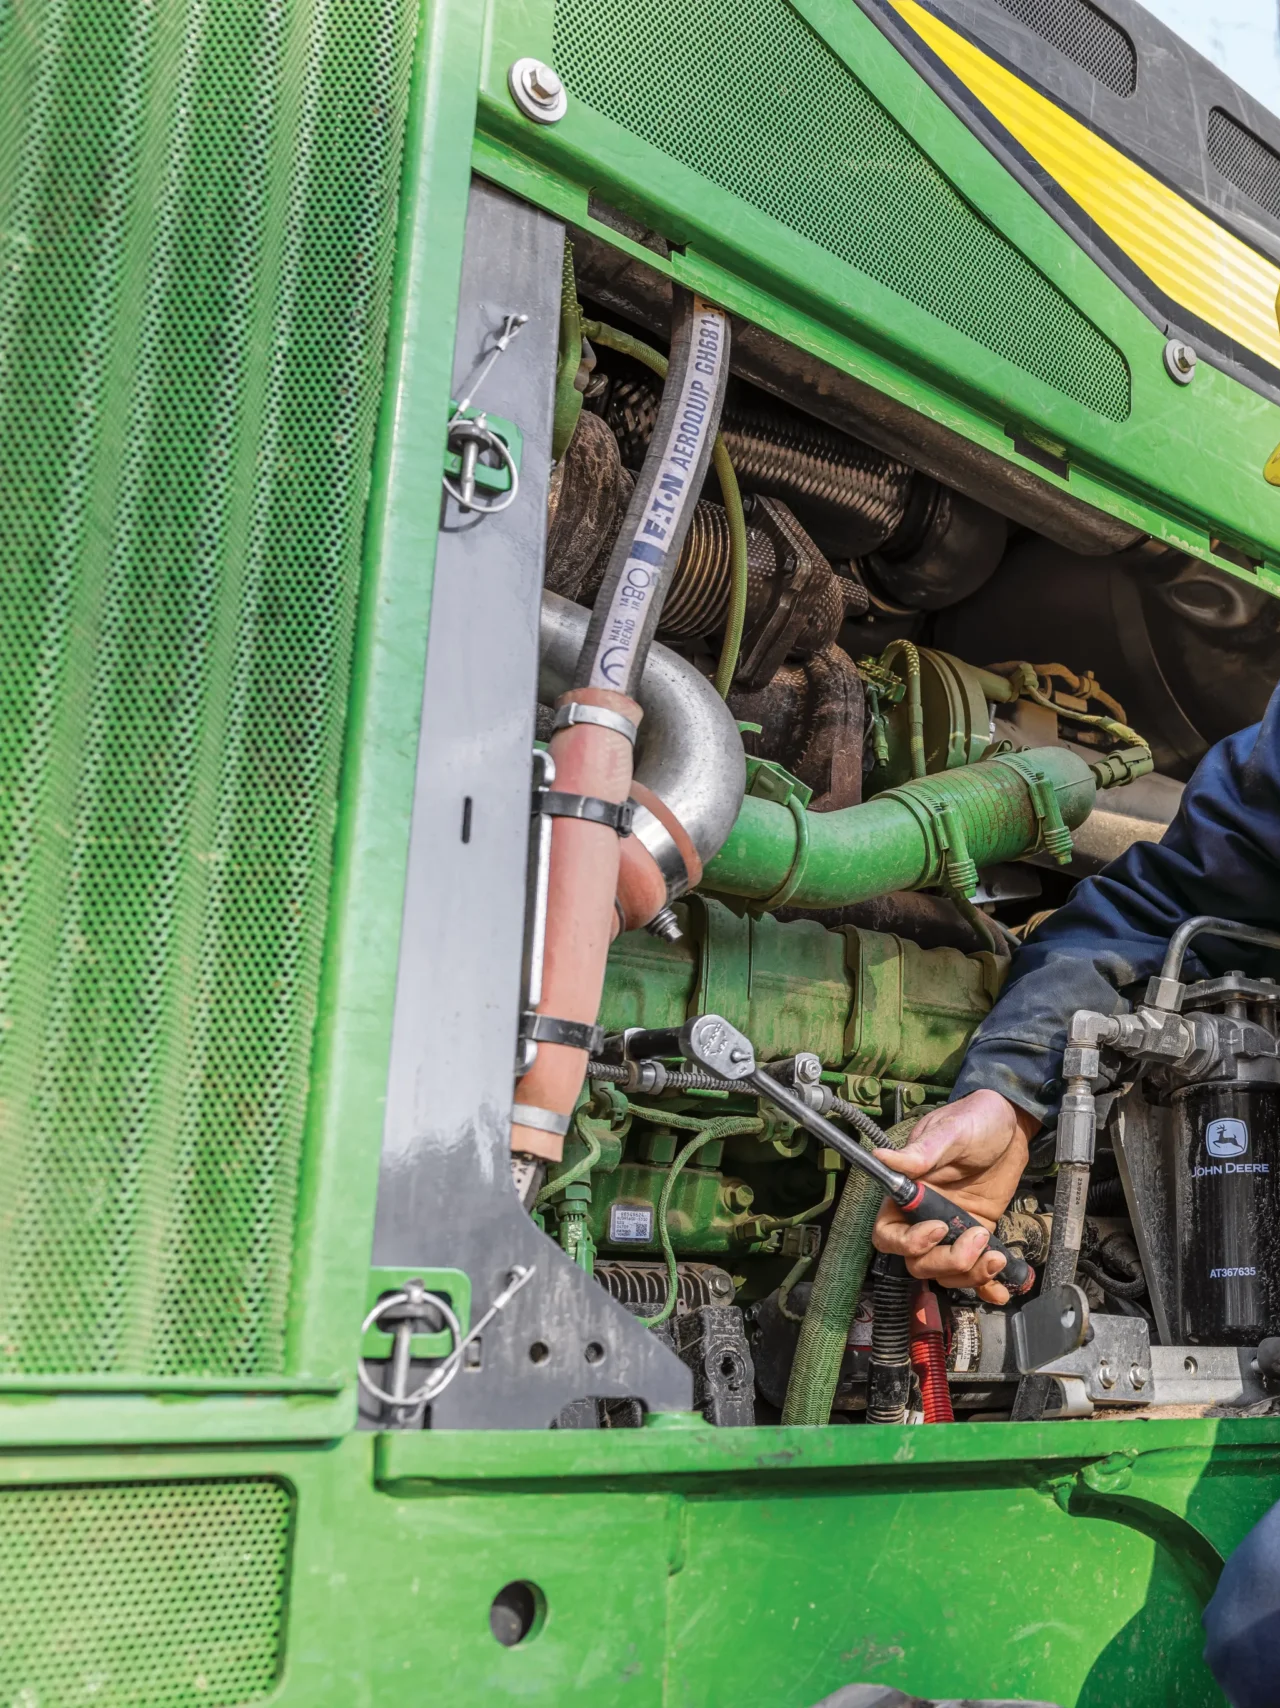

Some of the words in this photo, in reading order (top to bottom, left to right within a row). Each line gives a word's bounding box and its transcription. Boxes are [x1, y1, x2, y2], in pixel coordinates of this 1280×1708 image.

[642, 472, 685, 541] EATON
[669, 380, 711, 471] AEROQUIP
[608, 618, 624, 642] HALF
[619, 619, 636, 646] BEND
[1191, 1164, 1223, 1178] JOHN
[1225, 1162, 1270, 1175] DEERE
[1209, 1266, 1256, 1279] AT367635
